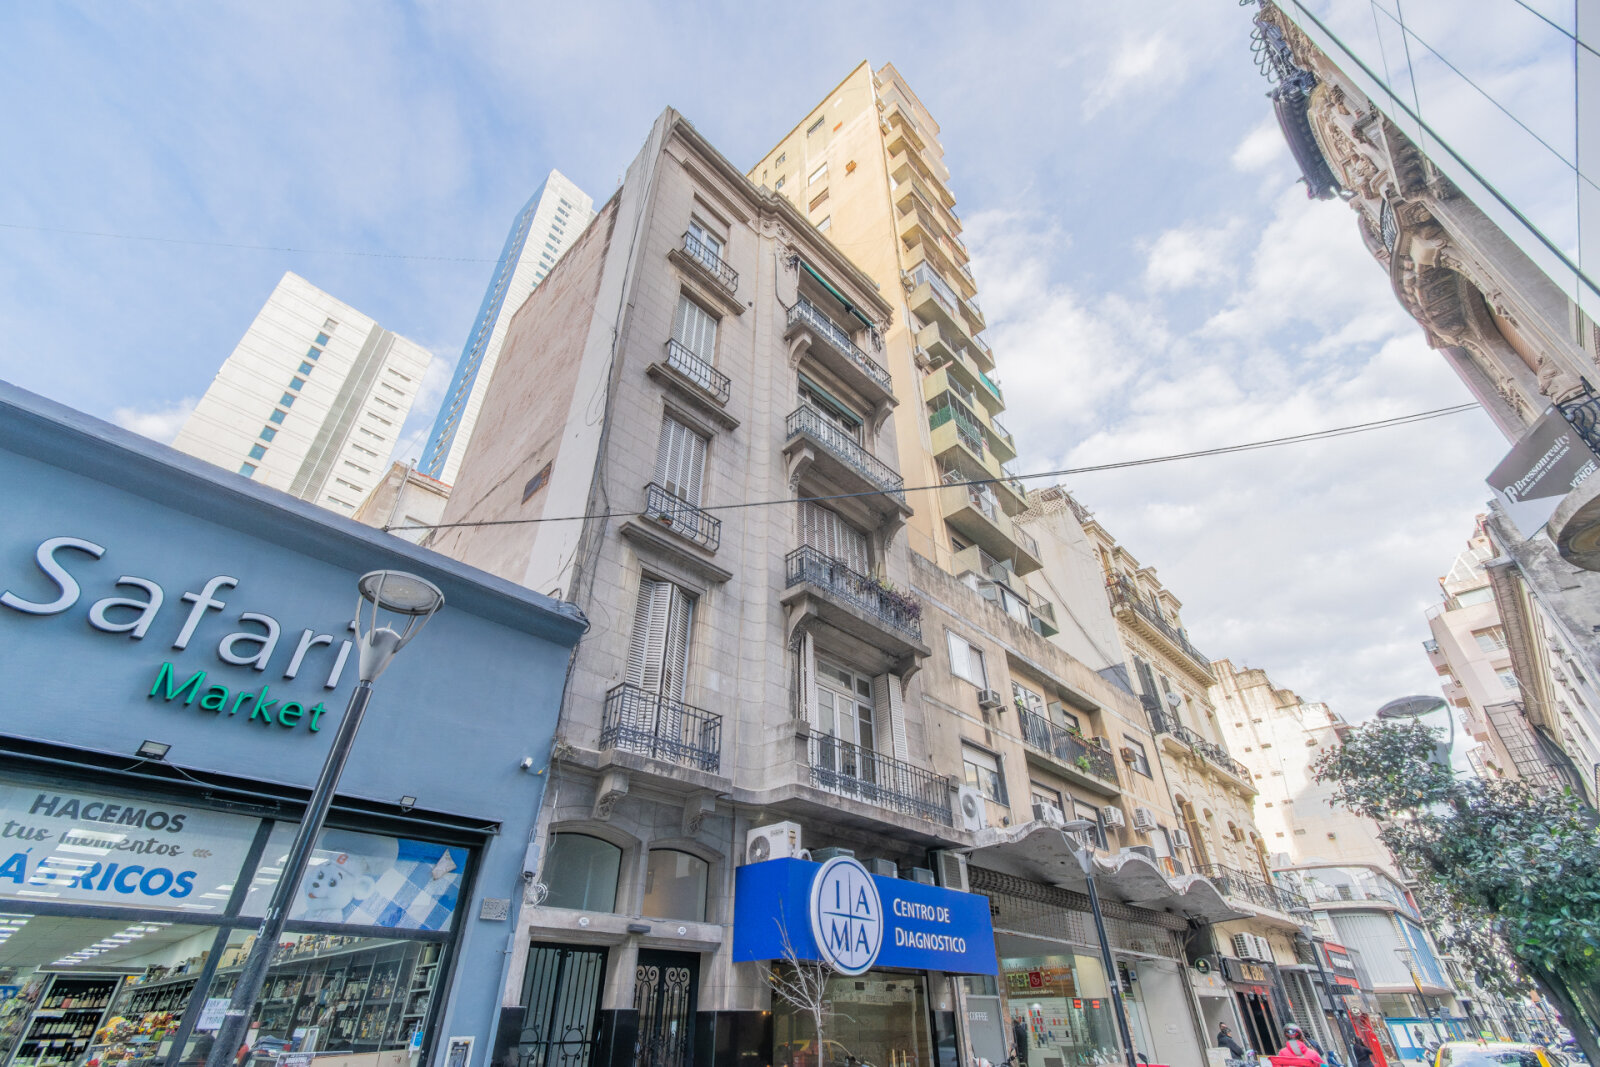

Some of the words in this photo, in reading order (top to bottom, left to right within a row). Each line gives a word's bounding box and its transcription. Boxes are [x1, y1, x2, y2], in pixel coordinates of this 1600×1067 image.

[1569, 461, 1597, 488] VENDE
[0, 536, 360, 690] Safari
[148, 661, 328, 733] Market
[28, 793, 187, 833] HACEMOS
[2, 820, 55, 842] tus
[68, 861, 197, 898] RICOS
[893, 898, 935, 922] CENTRO
[936, 906, 950, 923] DE
[895, 927, 966, 953] DIAGNOSTICO
